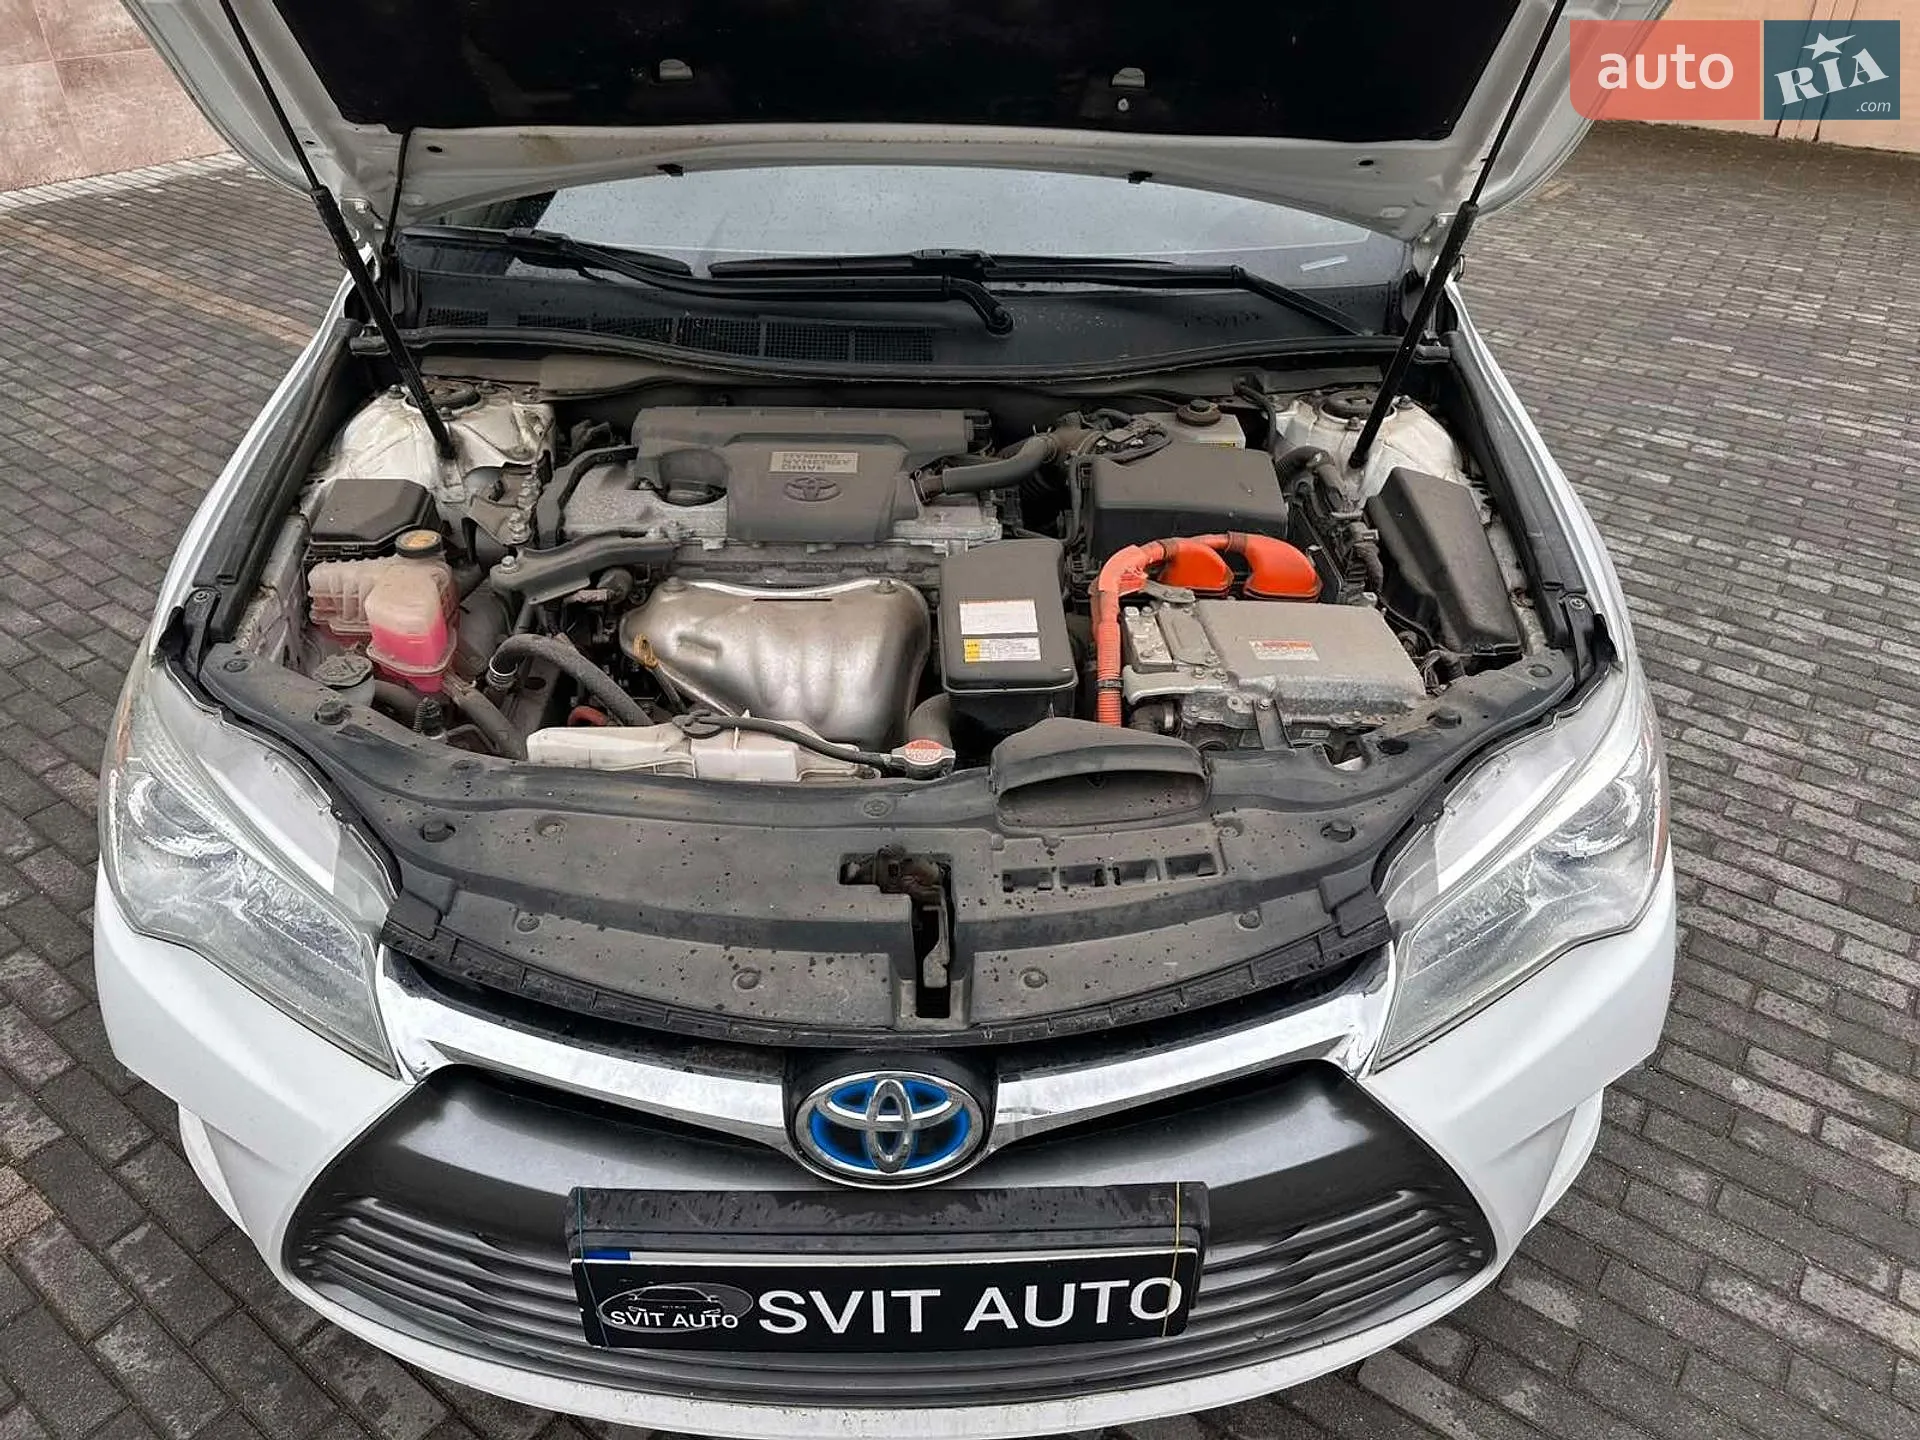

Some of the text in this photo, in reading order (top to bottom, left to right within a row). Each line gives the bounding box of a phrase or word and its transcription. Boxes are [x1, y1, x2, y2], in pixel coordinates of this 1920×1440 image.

[610, 1310, 739, 1330] SVIT AUTO
[758, 1275, 1183, 1335] SVIT AUTO
